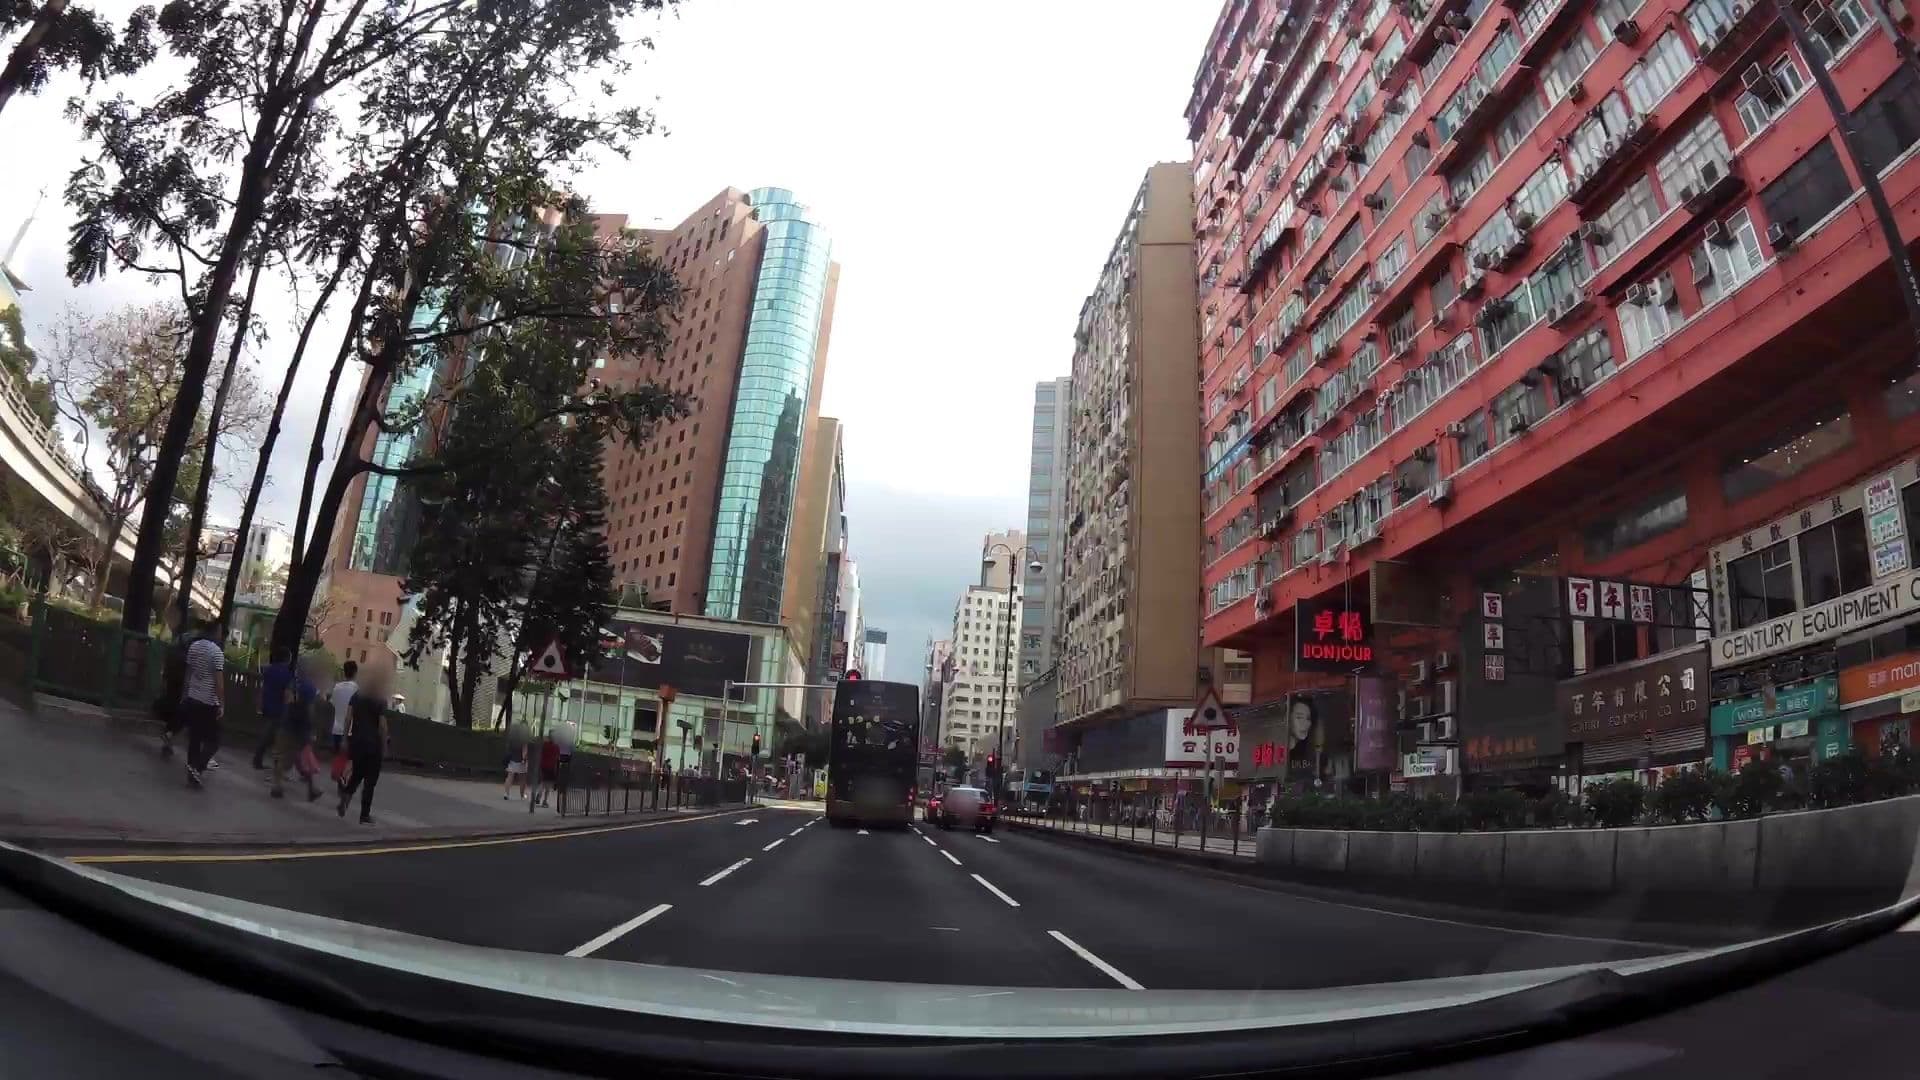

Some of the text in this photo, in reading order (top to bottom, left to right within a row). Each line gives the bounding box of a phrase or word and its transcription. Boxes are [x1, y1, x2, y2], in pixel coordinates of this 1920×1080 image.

[1722, 621, 1794, 660] CENTURY
[1802, 583, 1900, 638] EQUIPMENT
[1303, 643, 1372, 662] BONJOUR
[1680, 699, 1697, 713] LTD
